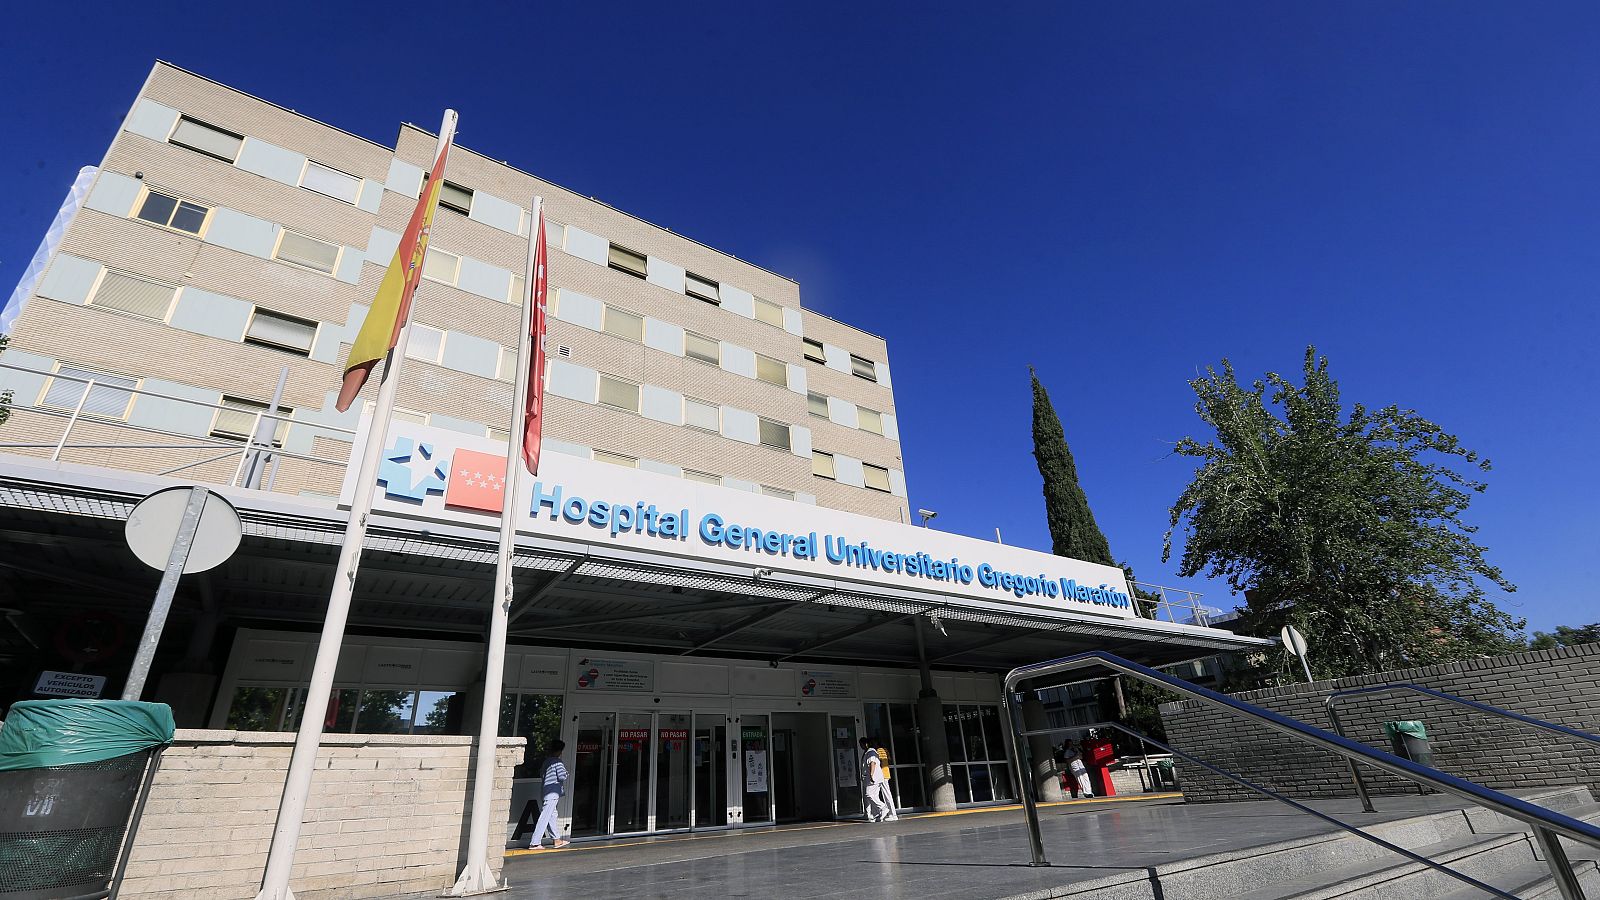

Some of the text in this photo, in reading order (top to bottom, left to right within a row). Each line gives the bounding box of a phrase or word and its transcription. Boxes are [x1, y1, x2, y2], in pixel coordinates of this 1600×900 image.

[530, 481, 1130, 610] Hospital General Universitario Gregorio Marañón
[54, 673, 93, 683] EXCEPTO
[47, 680, 96, 690] VEHÍCULOS
[37, 686, 98, 697] AUTORIZADOS
[511, 800, 546, 840] A
